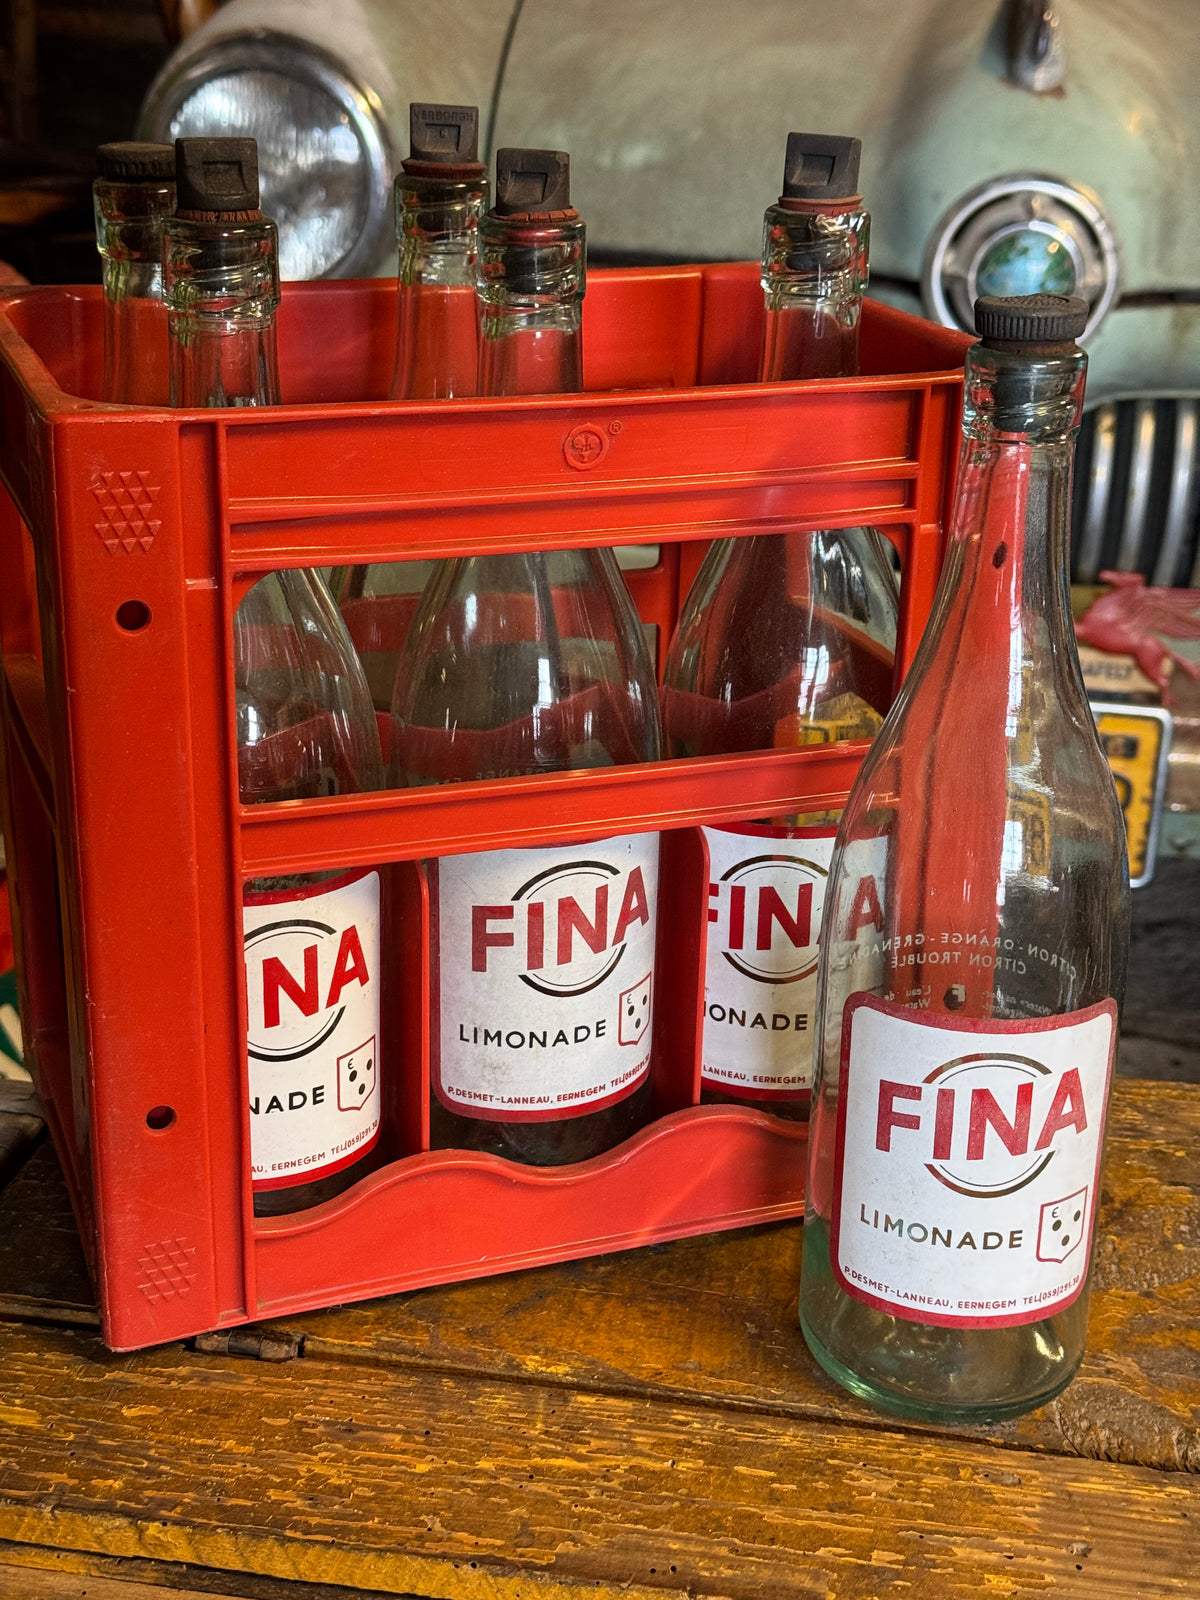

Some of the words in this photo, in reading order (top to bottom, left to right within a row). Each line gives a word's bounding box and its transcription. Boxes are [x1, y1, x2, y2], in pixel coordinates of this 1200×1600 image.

[472, 865, 649, 972] FINA
[245, 924, 370, 1032] NA
[703, 1001, 808, 1031] ONADE
[459, 1019, 606, 1049] LIMONADE
[557, 1083, 606, 1102] EERNEGEM
[752, 1075, 806, 1085] EERNEGEM
[249, 1085, 325, 1115] NADE
[876, 1067, 1088, 1160] FINA
[271, 1152, 326, 1171] EERNEGEM
[860, 1203, 1023, 1250] LIMONADE
[958, 1299, 1016, 1310] EERNEGEM
